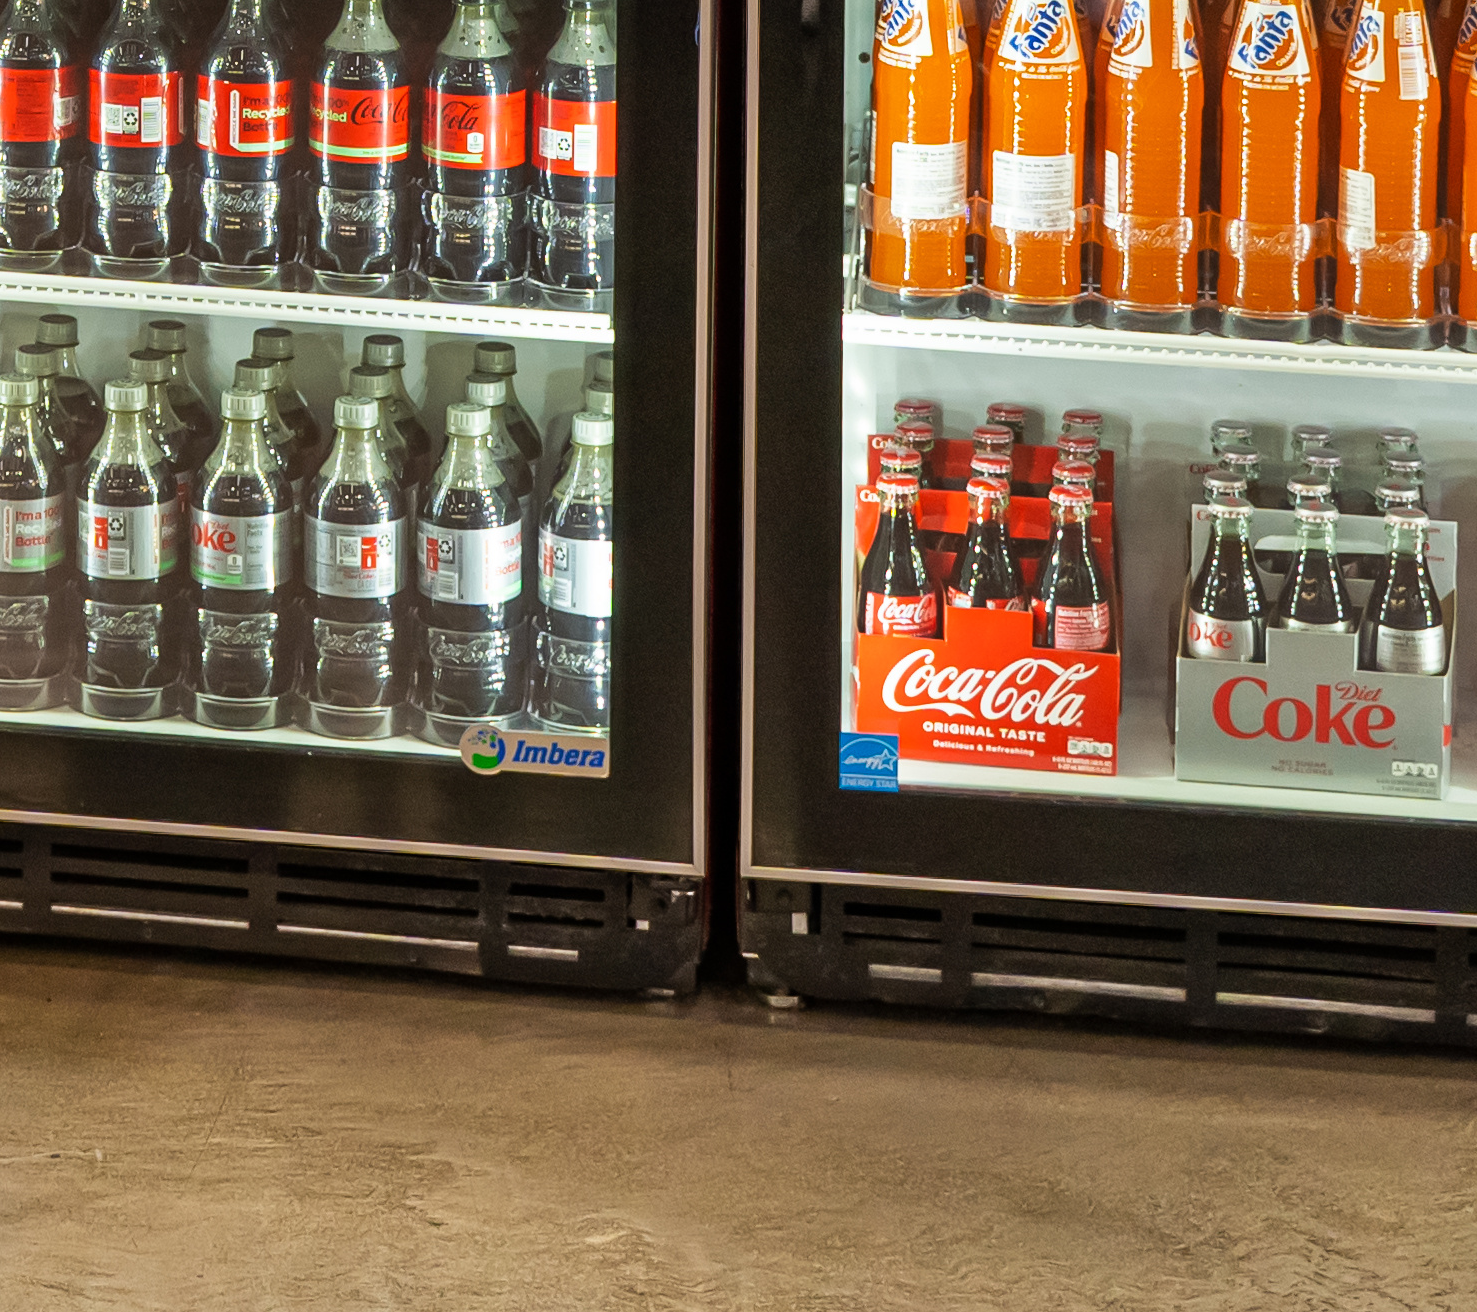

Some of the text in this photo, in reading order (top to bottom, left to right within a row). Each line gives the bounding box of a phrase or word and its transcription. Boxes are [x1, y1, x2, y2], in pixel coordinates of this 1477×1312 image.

[1237, 9, 1296, 71] Fanta
[881, 648, 1099, 729] Coca-Cola
[1334, 680, 1383, 702] Diet
[1211, 675, 1397, 750] Coke
[922, 719, 1046, 744] ORIGINAL TASTE
[932, 739, 976, 753] Delicious
[510, 739, 606, 771] Imbera
